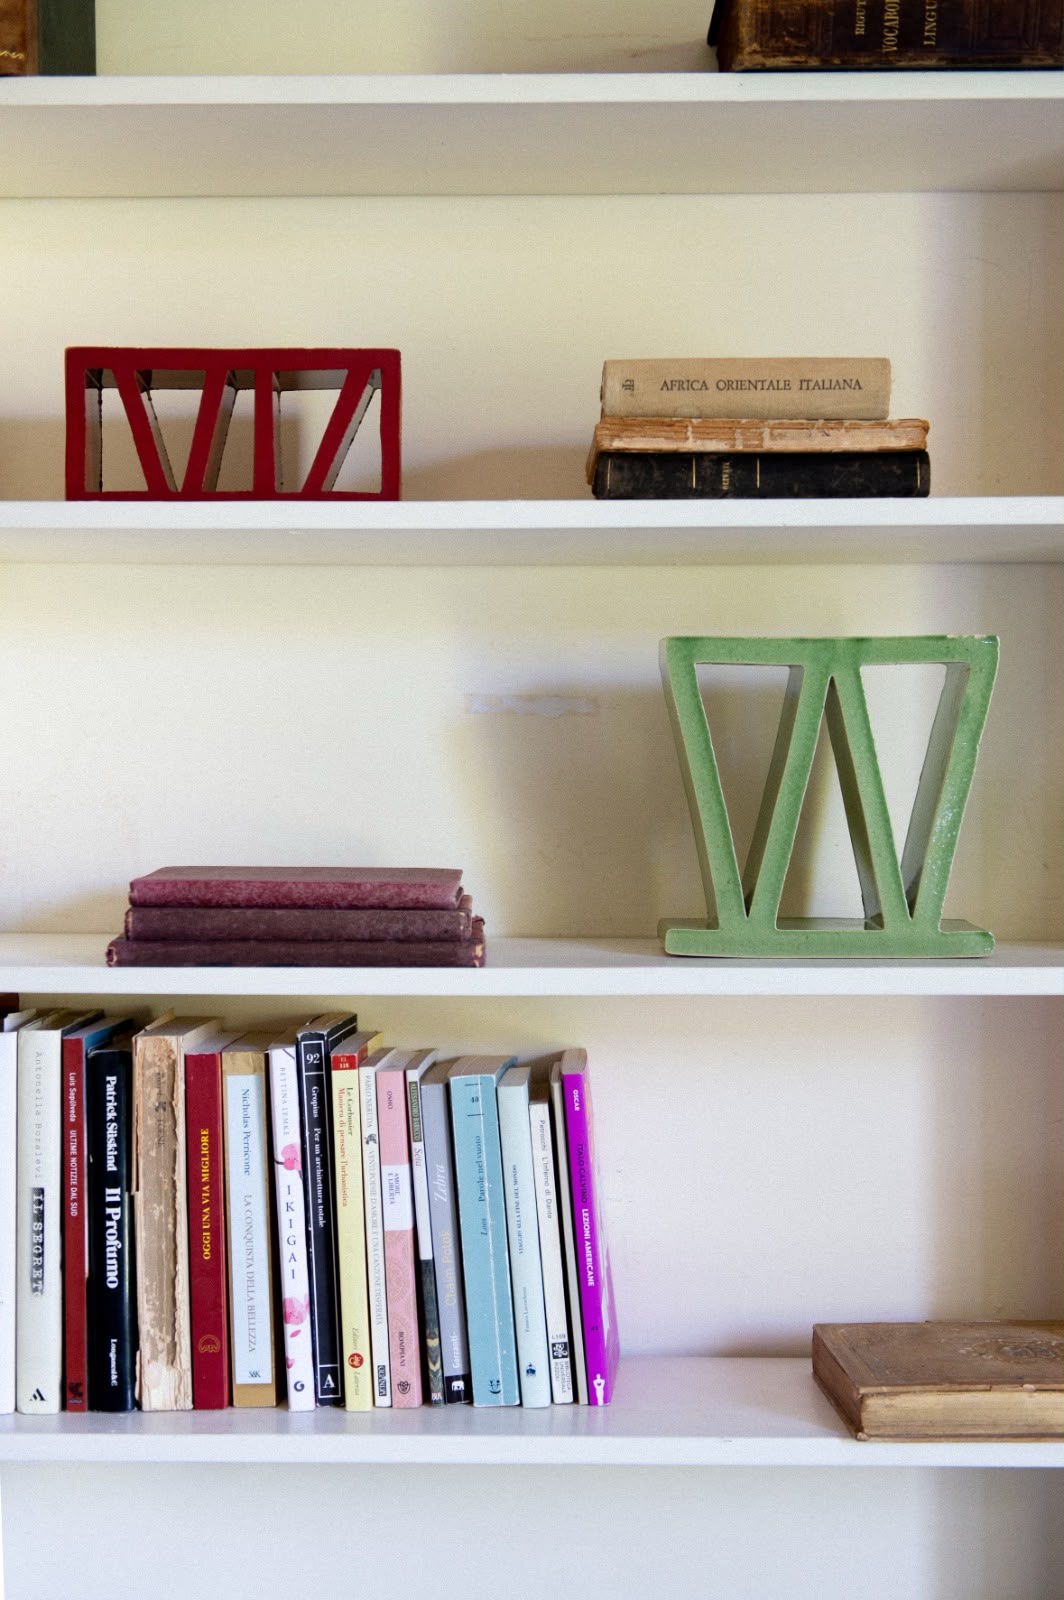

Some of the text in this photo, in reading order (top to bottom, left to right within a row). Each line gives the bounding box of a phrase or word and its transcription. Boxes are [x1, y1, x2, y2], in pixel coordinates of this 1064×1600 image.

[660, 379, 862, 391] AFRICA ORIENTALE ITALIANA
[306, 1053, 320, 1064] 92
[68, 1072, 77, 1122] Luis Sepúlveda
[280, 1067, 290, 1136] BETTINA LEMKE
[310, 1086, 320, 1118] Gropius
[338, 1088, 346, 1118] Maniera
[347, 1087, 355, 1136] Le Corbusier
[35, 1051, 43, 1178] Antonella Boralevi
[106, 1075, 118, 1172] Patrick Süskind
[339, 1120, 347, 1128] di
[241, 1088, 251, 1176] Nicholas Perricone
[313, 1127, 322, 1141] Per
[337, 1130, 346, 1157] pensare
[474, 1135, 482, 1159] vuoto
[539, 1119, 548, 1151] Petrocchi
[70, 1157, 78, 1185] NOTIZIE
[415, 1149, 423, 1167] Seta
[475, 1161, 484, 1173] nel
[70, 1187, 78, 1201] DAL
[200, 1128, 211, 1260] OGGI UNA VIA MIGLIORE
[433, 1164, 448, 1201] Zebra
[477, 1176, 486, 1202] Parole
[33, 1194, 43, 1214] IL
[318, 1205, 327, 1228] totale
[577, 1143, 595, 1287] ITALO CALVINO LEZIONI AMERICANE
[105, 1207, 122, 1289] Profumo
[243, 1194, 256, 1353] LA CONQUISTA DELLA BELLEZZA
[398, 1331, 406, 1367] BOMPIANI
